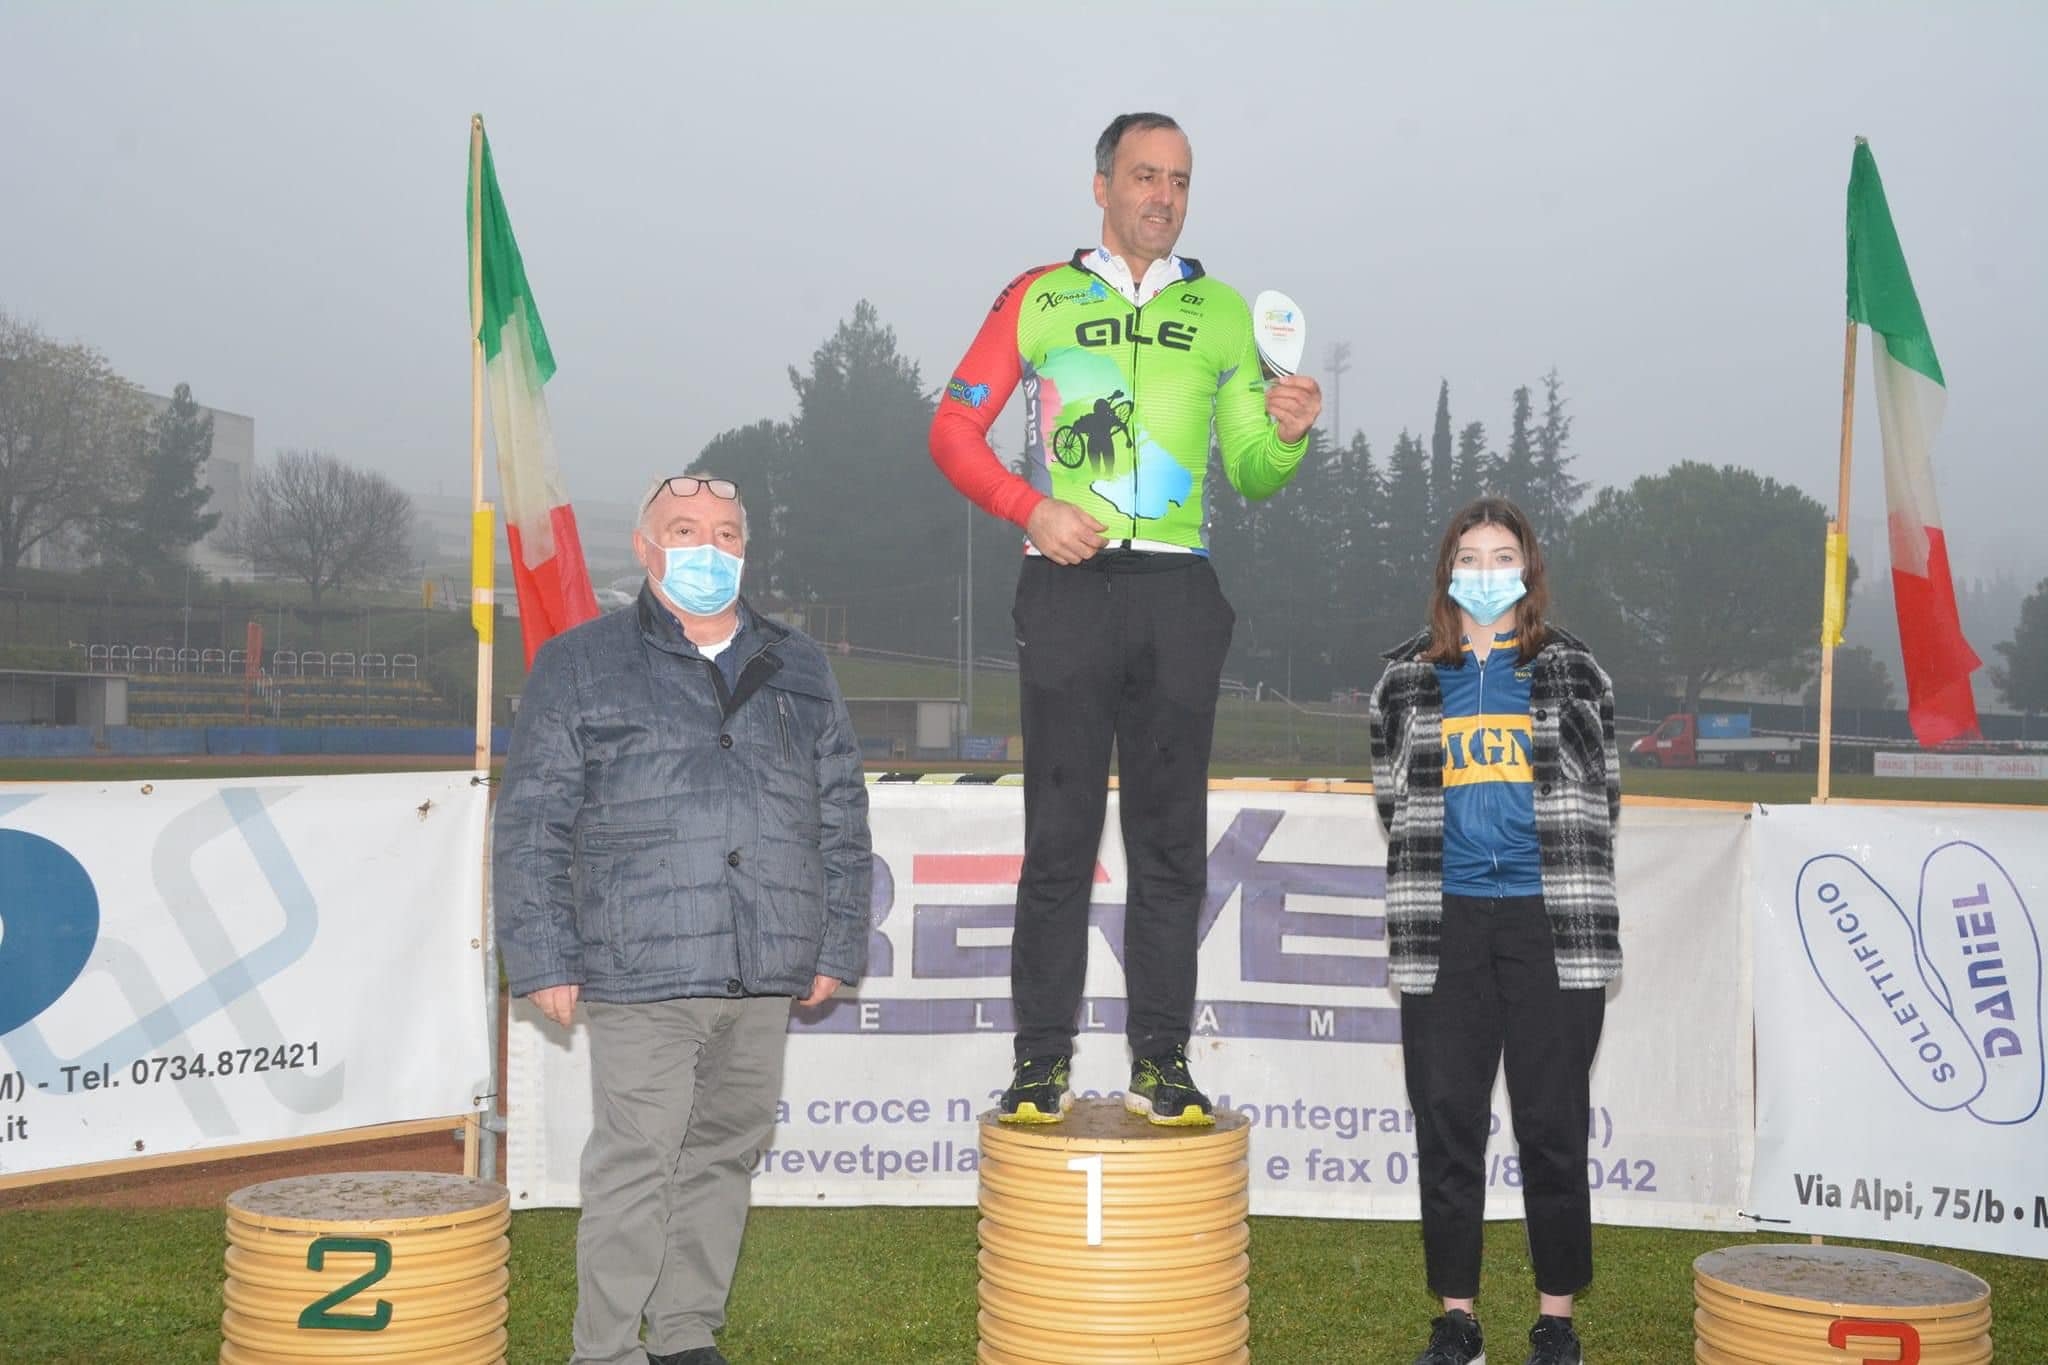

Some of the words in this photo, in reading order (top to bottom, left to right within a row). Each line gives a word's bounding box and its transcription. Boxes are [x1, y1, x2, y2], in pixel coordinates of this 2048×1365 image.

[1817, 882, 1956, 1084] SOLETTIFICIO
[59, 1063, 120, 1093] Tel.
[131, 1041, 319, 1085] 0734.872421
[807, 1097, 931, 1125] croce
[1266, 1155, 1290, 1180] e
[1305, 1148, 1372, 1183] fax
[1067, 1154, 1103, 1246] 1
[1794, 1173, 1841, 1208] Via
[1850, 1178, 1923, 1221] Alpi,
[1932, 1186, 2005, 1224] 75/b
[298, 1236, 393, 1331] 2
